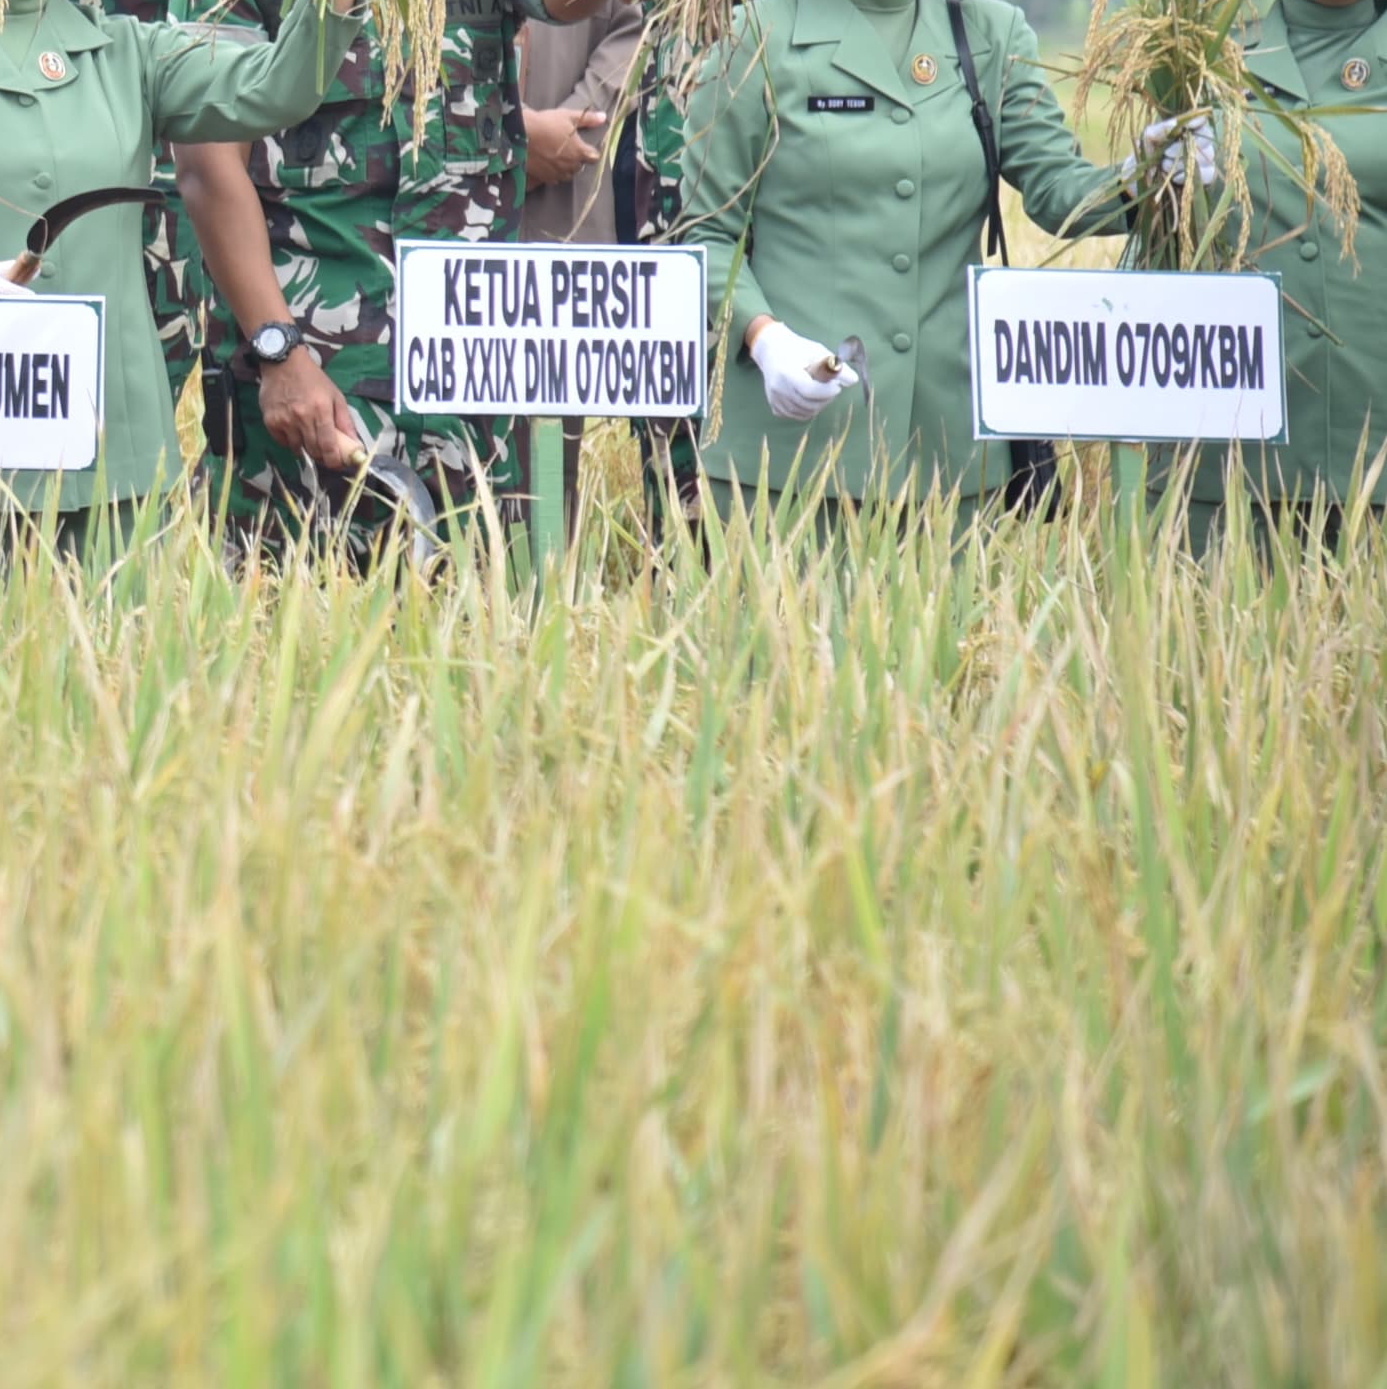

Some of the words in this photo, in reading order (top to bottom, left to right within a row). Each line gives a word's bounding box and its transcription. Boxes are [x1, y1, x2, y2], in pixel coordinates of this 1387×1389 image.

[443, 258, 543, 328] KETUA
[550, 259, 658, 330] PERSIT
[407, 336, 457, 403] CAB
[462, 337, 518, 403] XXIX
[524, 338, 569, 404] DIM
[575, 338, 697, 406] 0709/KBM
[994, 319, 1109, 386] DANDIM
[1115, 321, 1265, 391] 0709/KBM
